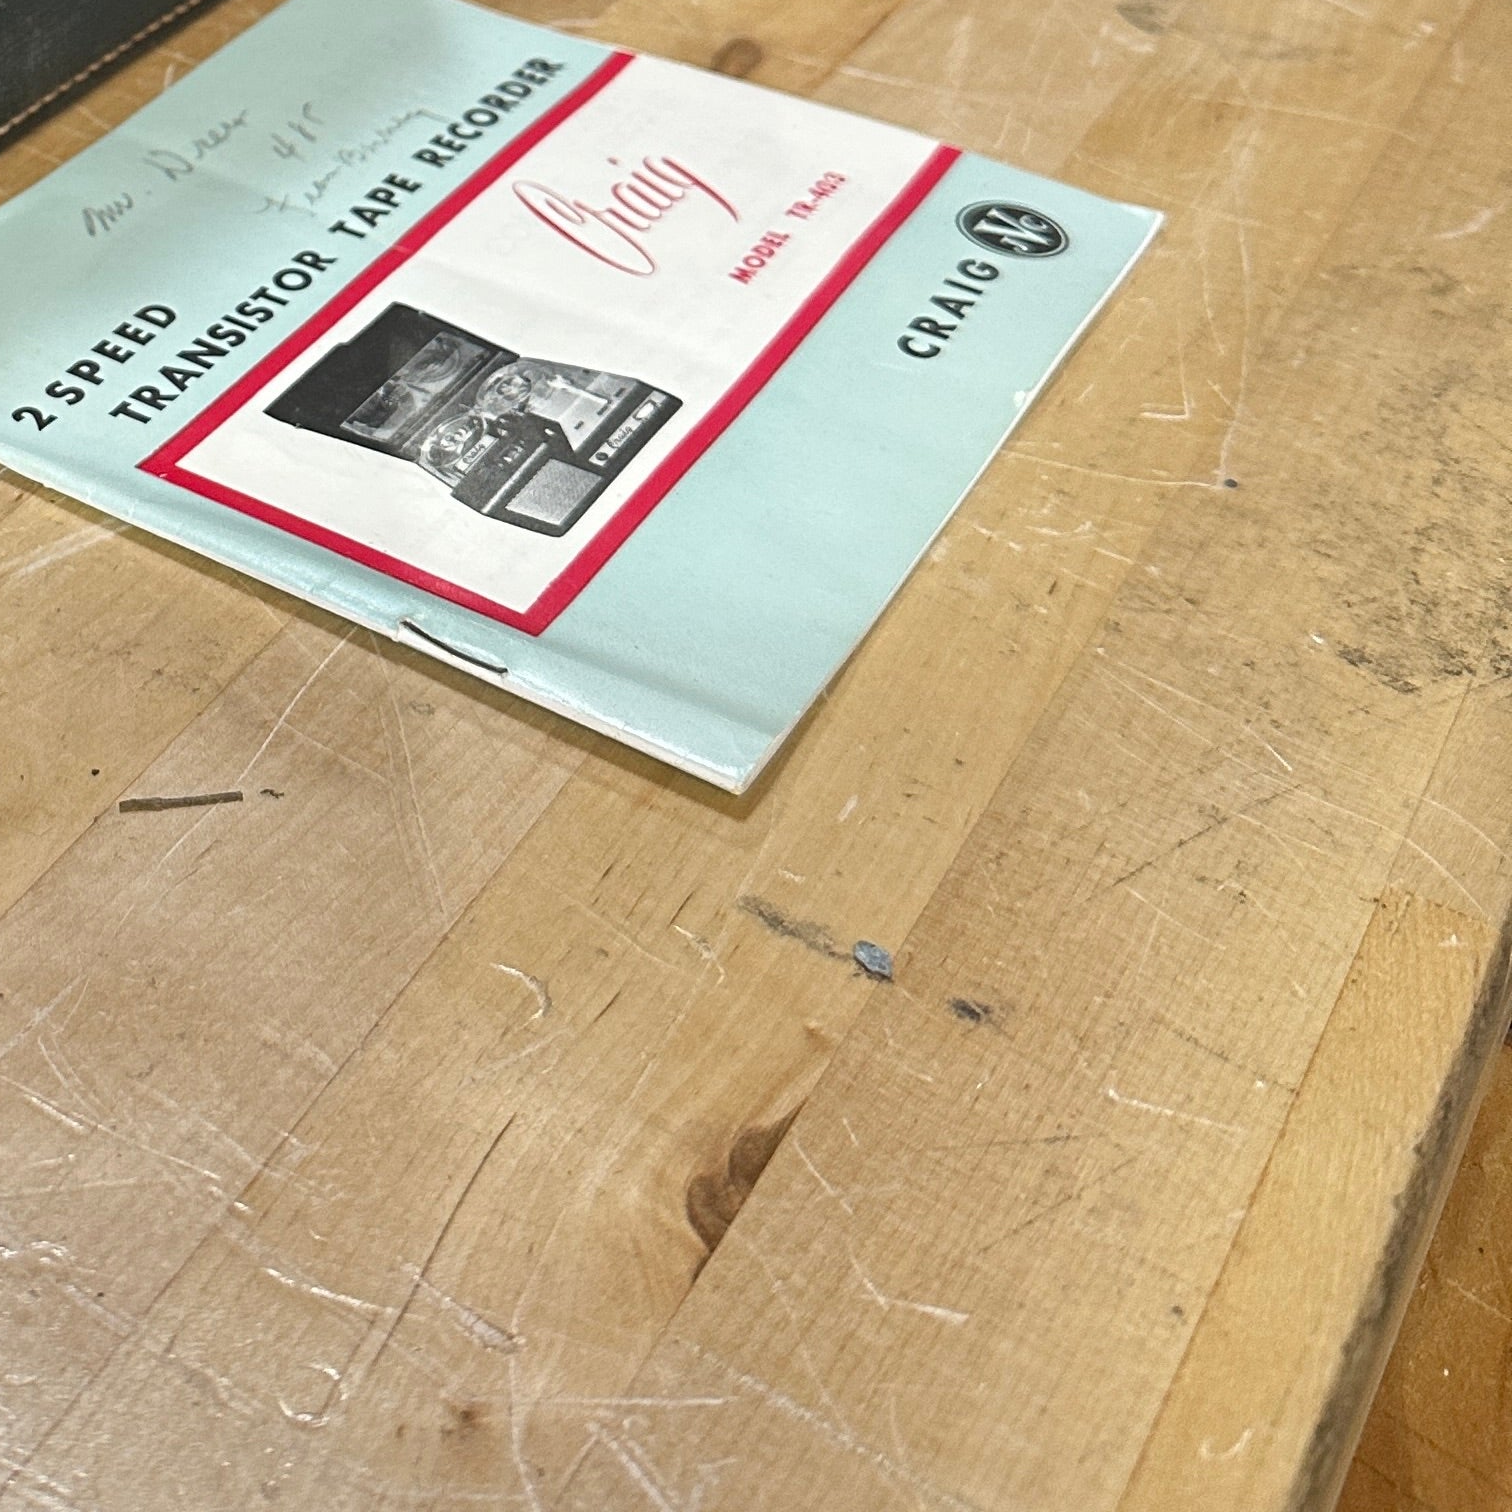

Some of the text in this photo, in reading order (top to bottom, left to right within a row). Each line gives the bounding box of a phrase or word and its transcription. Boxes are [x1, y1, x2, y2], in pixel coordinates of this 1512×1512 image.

[108, 250, 339, 425] TRANSISTOR
[326, 173, 424, 240] TAPE
[411, 56, 566, 169] RECORDER
[512, 155, 741, 276] Craig
[727, 230, 790, 285] MODEL
[11, 304, 177, 431] 2 SPEED
[896, 257, 1000, 360] CRAIG
